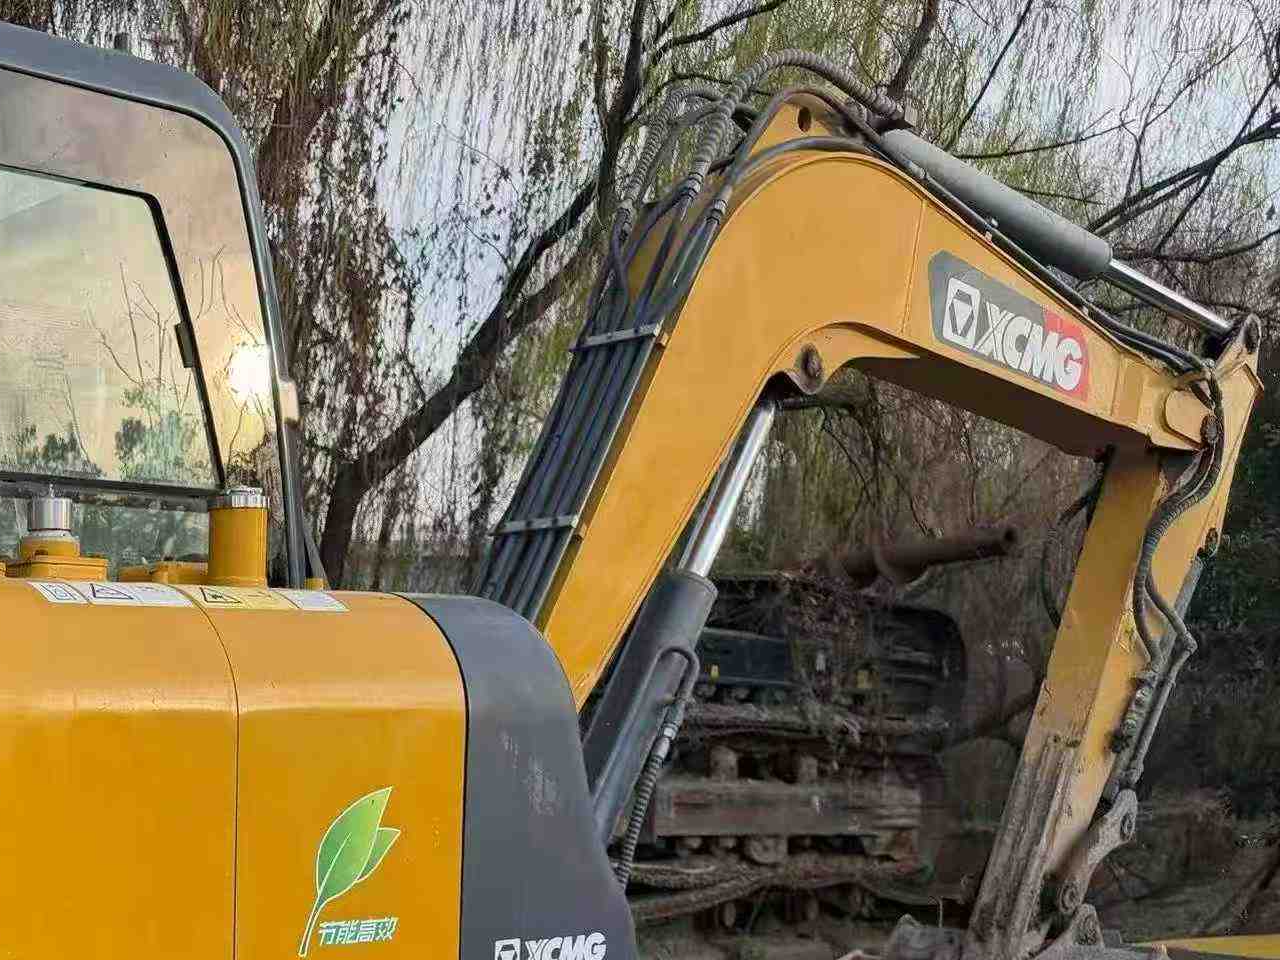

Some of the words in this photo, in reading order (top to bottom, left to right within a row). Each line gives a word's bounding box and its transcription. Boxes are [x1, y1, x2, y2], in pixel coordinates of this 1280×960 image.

[975, 301, 1082, 391] XCMG
[319, 916, 400, 946] 节能高效
